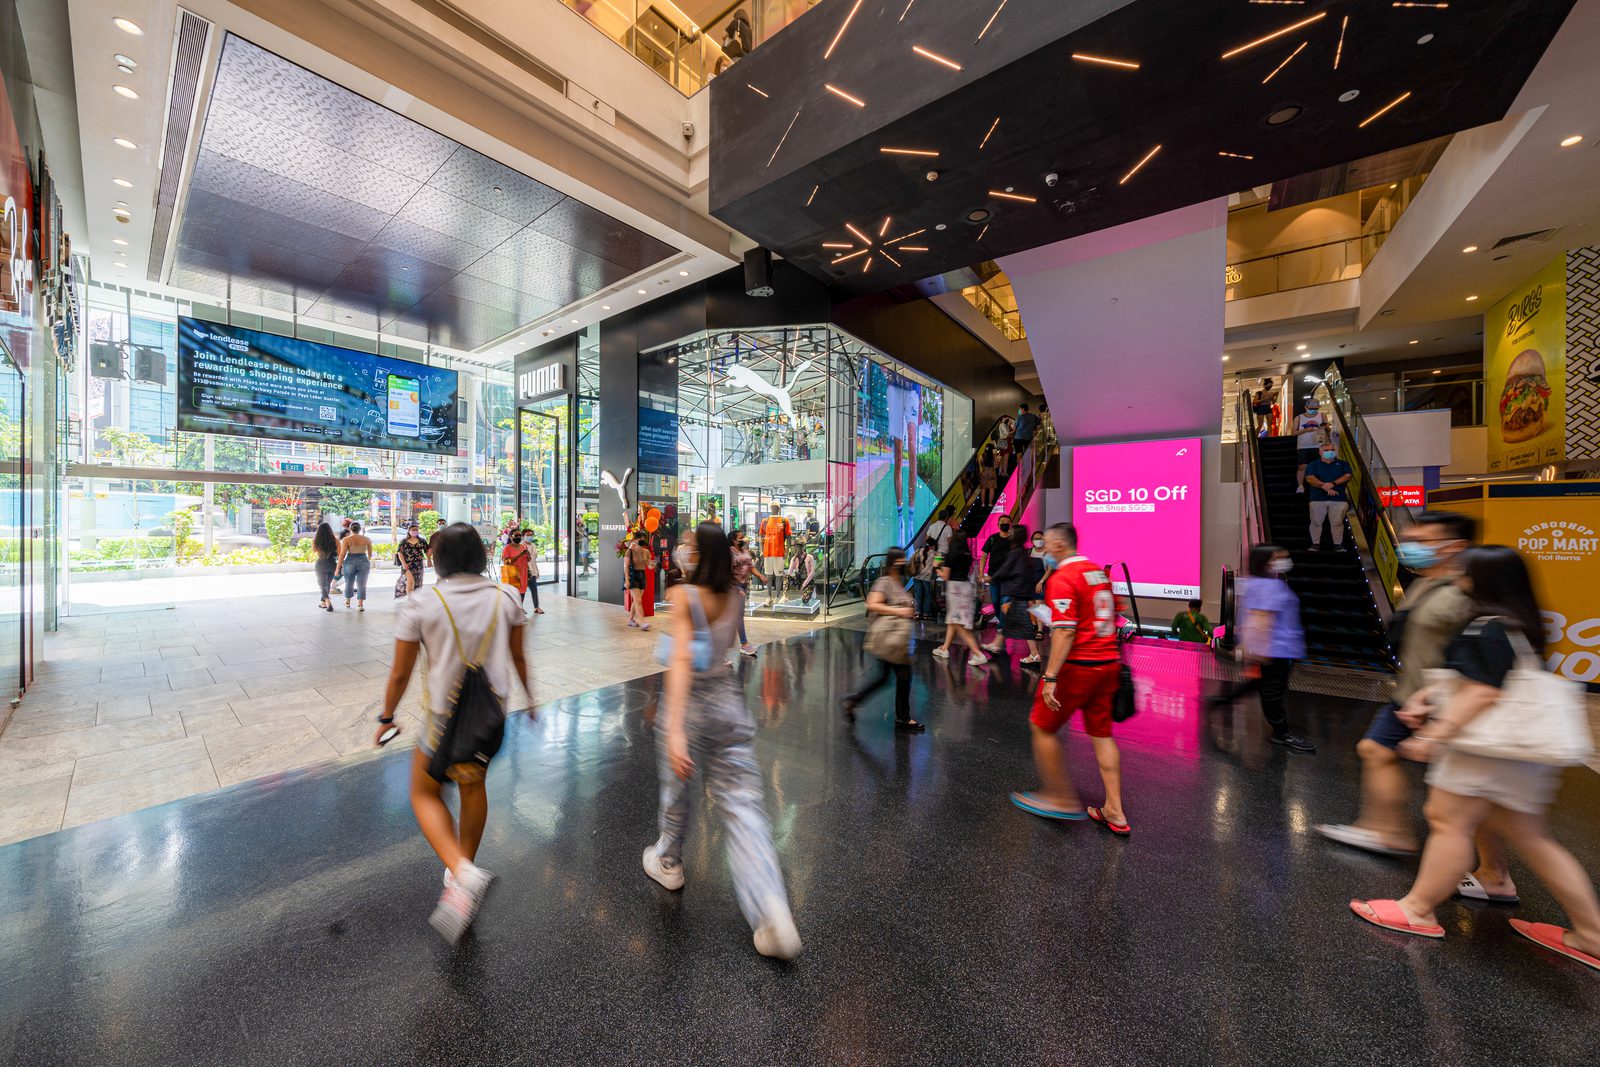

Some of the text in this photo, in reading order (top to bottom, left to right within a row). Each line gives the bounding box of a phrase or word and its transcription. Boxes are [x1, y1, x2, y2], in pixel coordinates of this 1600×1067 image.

[1507, 284, 1542, 338] BURGS
[210, 333, 249, 346] lendlease
[194, 350, 216, 361] Join
[220, 355, 269, 369] Lendlease
[273, 363, 294, 374] Plus
[297, 367, 321, 379] today
[323, 372, 336, 381] for
[194, 361, 343, 390] rewarding shopping experience
[203, 373, 228, 381] rewarded
[520, 363, 560, 399] PUMA
[193, 377, 236, 389] 313@somerset,
[252, 386, 272, 394] Parkway
[1085, 485, 1187, 502] SGD 10 Off
[1105, 504, 1126, 512] Shop
[1524, 521, 1594, 536] ROBOSHOP
[1518, 538, 1599, 551] POP MART
[1163, 587, 1182, 595] Level
